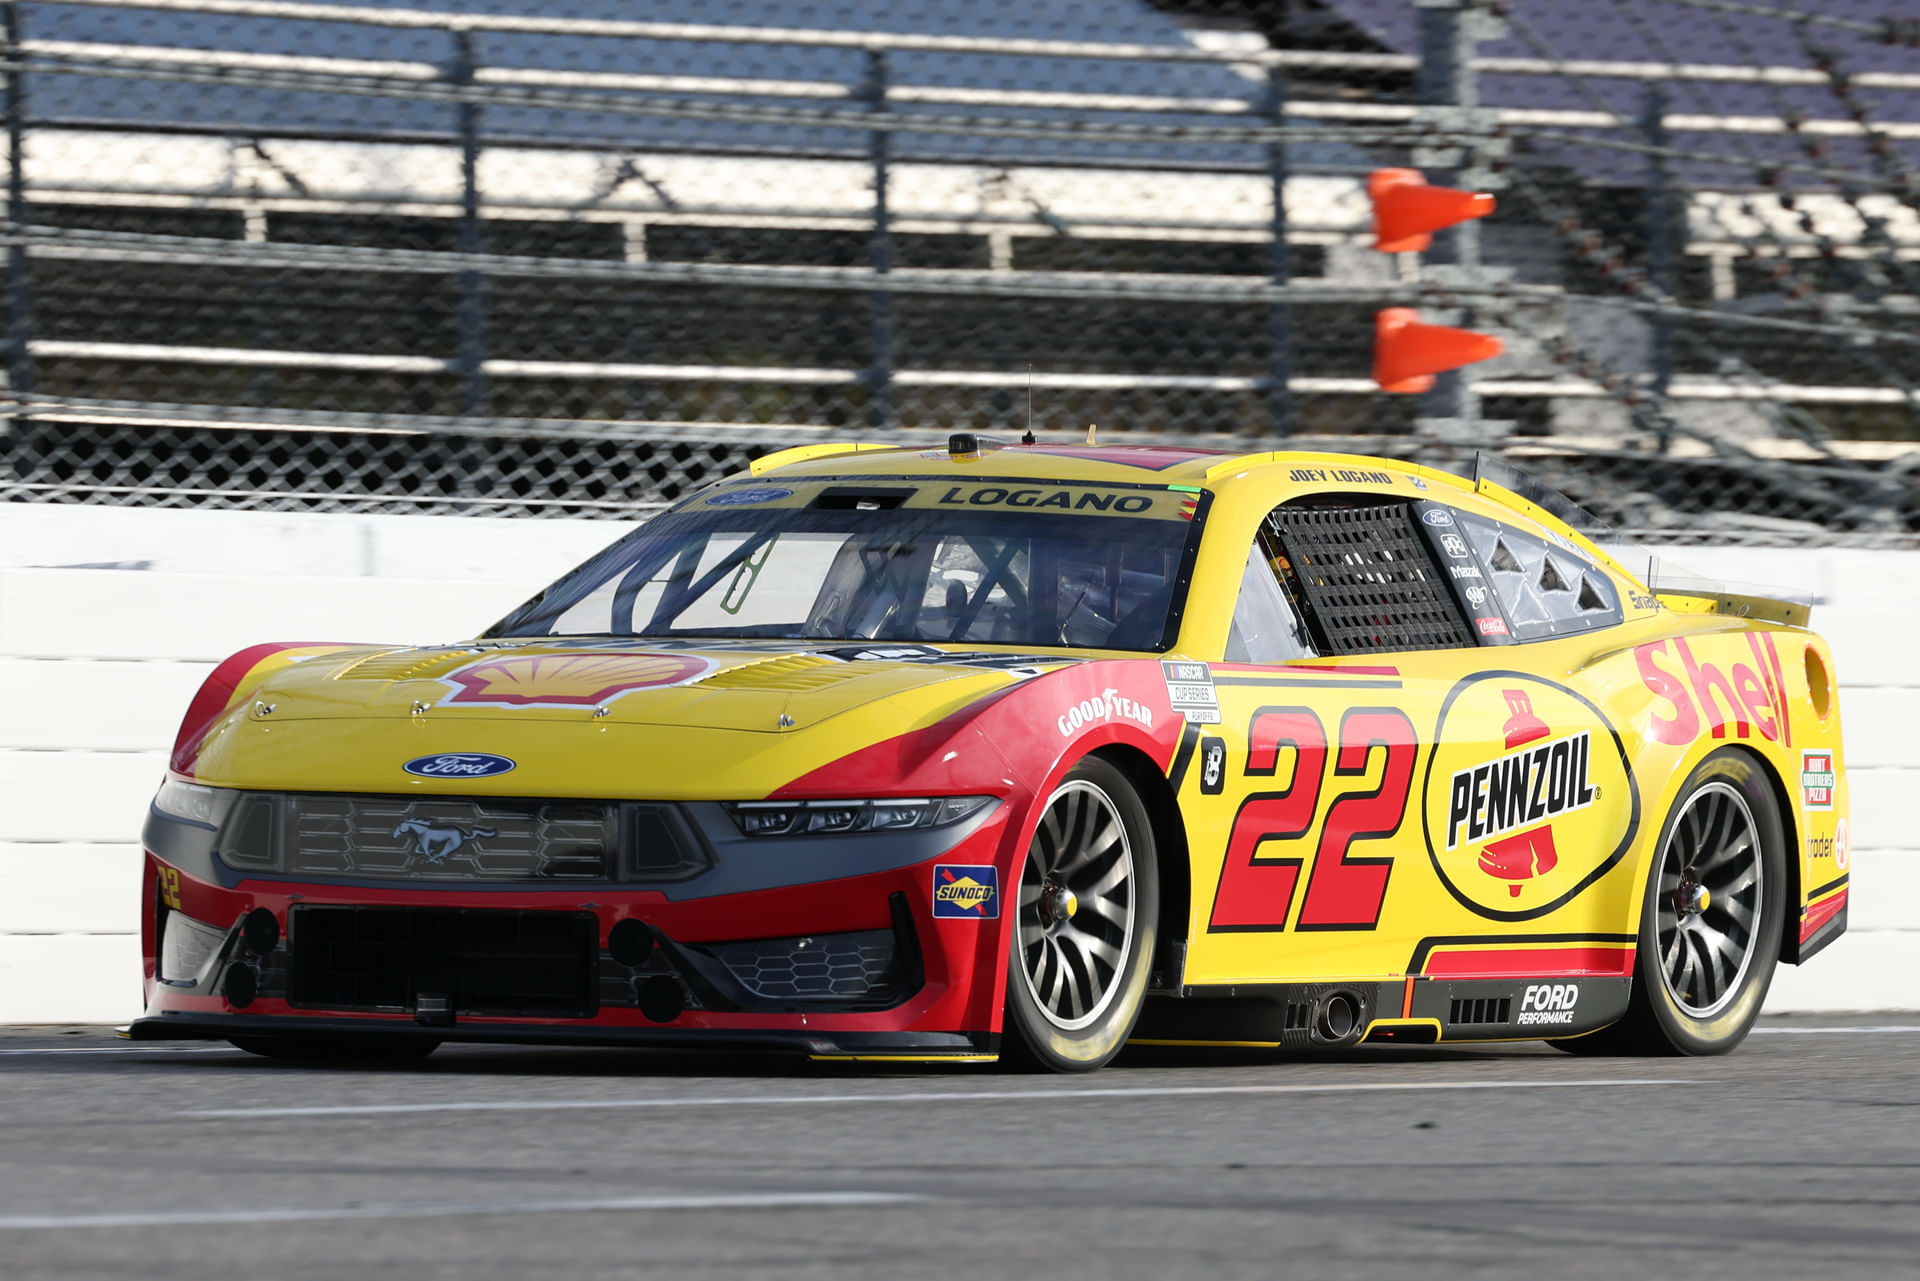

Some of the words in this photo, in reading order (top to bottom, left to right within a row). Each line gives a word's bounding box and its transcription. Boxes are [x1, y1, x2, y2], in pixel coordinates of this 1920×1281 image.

[1290, 469, 1328, 482] JOEY
[1330, 470, 1393, 484] LOGANO
[938, 487, 1153, 513] LOGANO
[1178, 665, 1205, 680] NASCAR
[1175, 687, 1188, 700] CUP
[1189, 688, 1210, 701] SERIES
[1634, 631, 1791, 748] Shell
[422, 755, 496, 775] Ford
[1446, 731, 1597, 851] PENNZOIL
[1207, 706, 1419, 934] 22
[939, 886, 992, 900] SUNOCO
[1521, 984, 1579, 1011] FORD
[1517, 1010, 1574, 1025] PERFORMANCE
